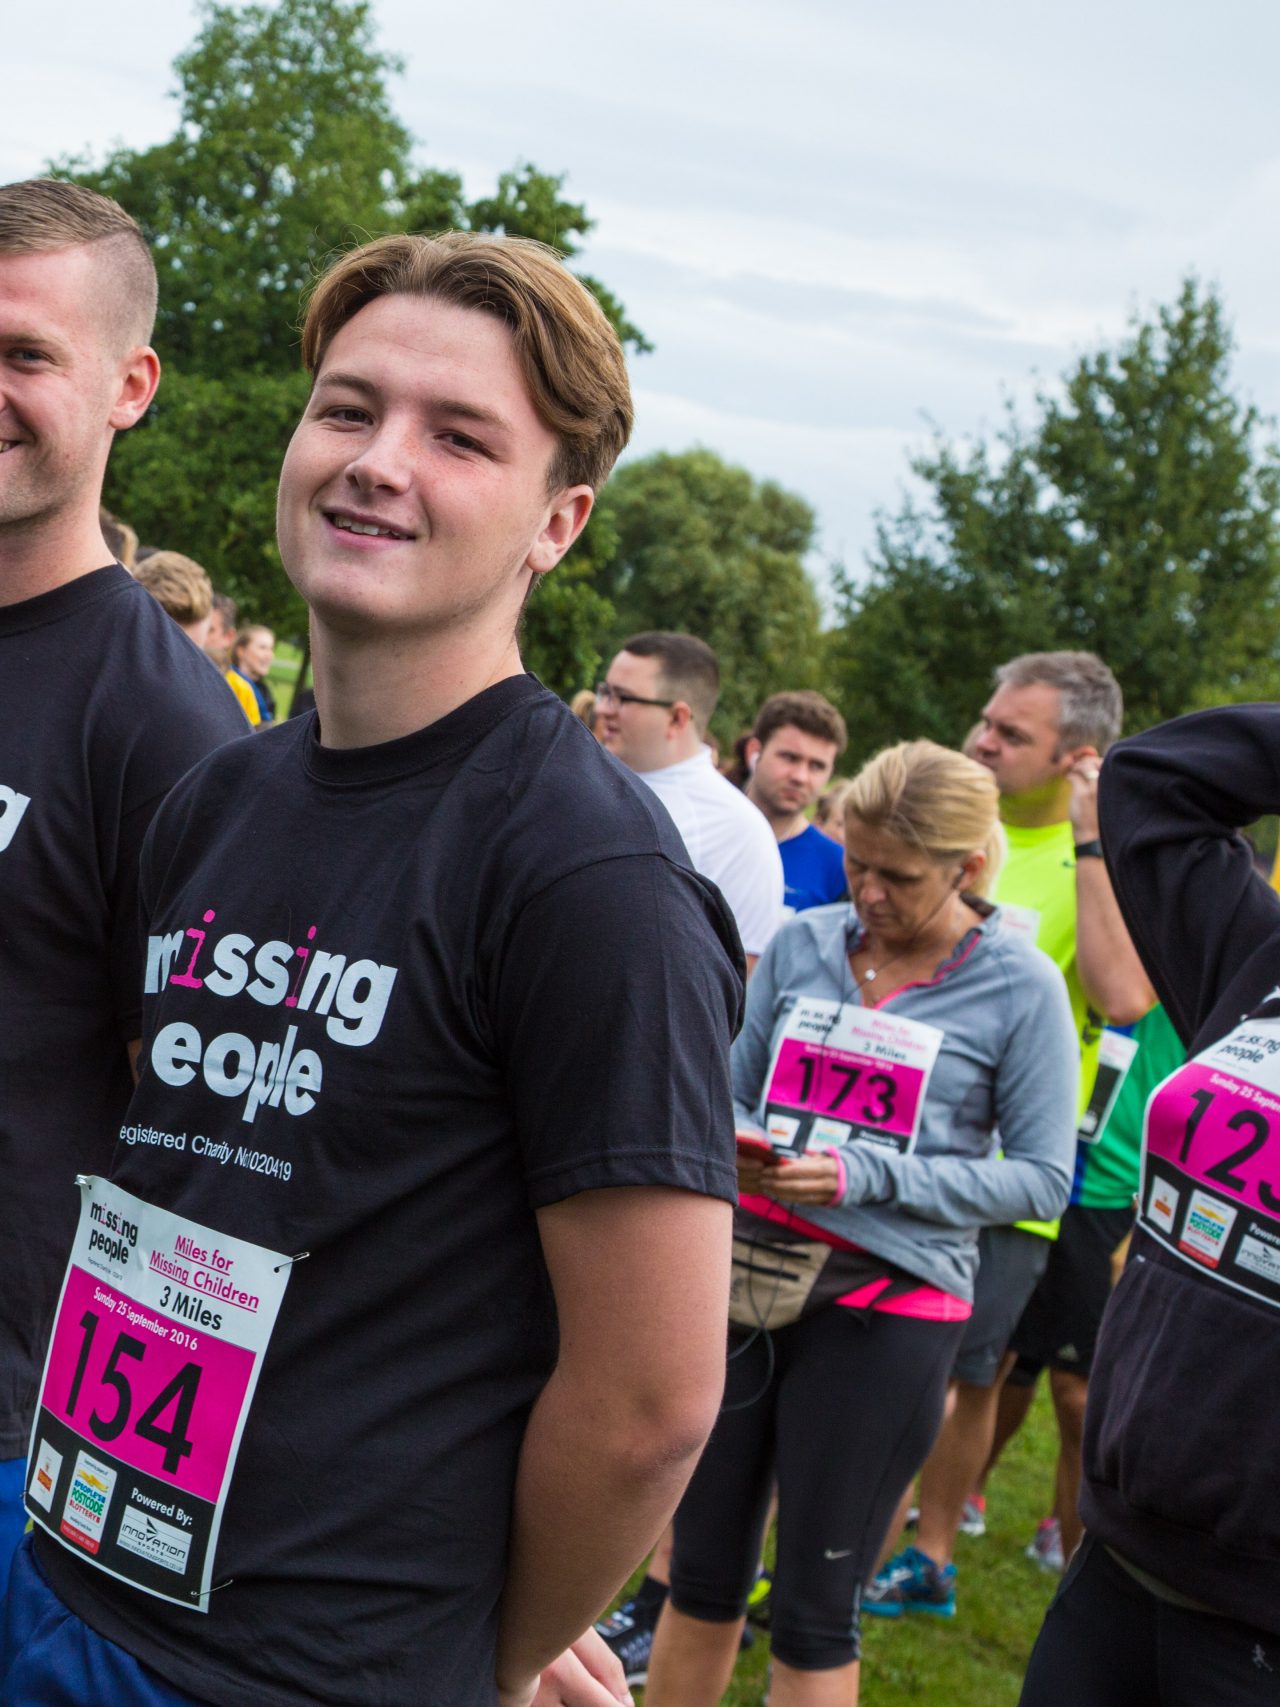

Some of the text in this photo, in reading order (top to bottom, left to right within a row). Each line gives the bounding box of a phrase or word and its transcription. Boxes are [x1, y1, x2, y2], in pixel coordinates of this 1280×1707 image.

[151, 1021, 323, 1123] eople
[798, 1056, 897, 1123] 173
[120, 1124, 186, 1150] egistered
[88, 1228, 129, 1264] people
[90, 1201, 138, 1247] missing
[175, 1235, 234, 1272] Miles for
[150, 1250, 190, 1284] Missing
[193, 1270, 259, 1309] Children
[93, 1286, 198, 1351] Sunday 25 September 2016
[159, 1285, 223, 1330] 3 Miles
[65, 1310, 203, 1475] 154
[71, 1487, 104, 1516] POSTCODE
[71, 1500, 98, 1522] LOTTERY
[131, 1487, 193, 1526] Powered By:
